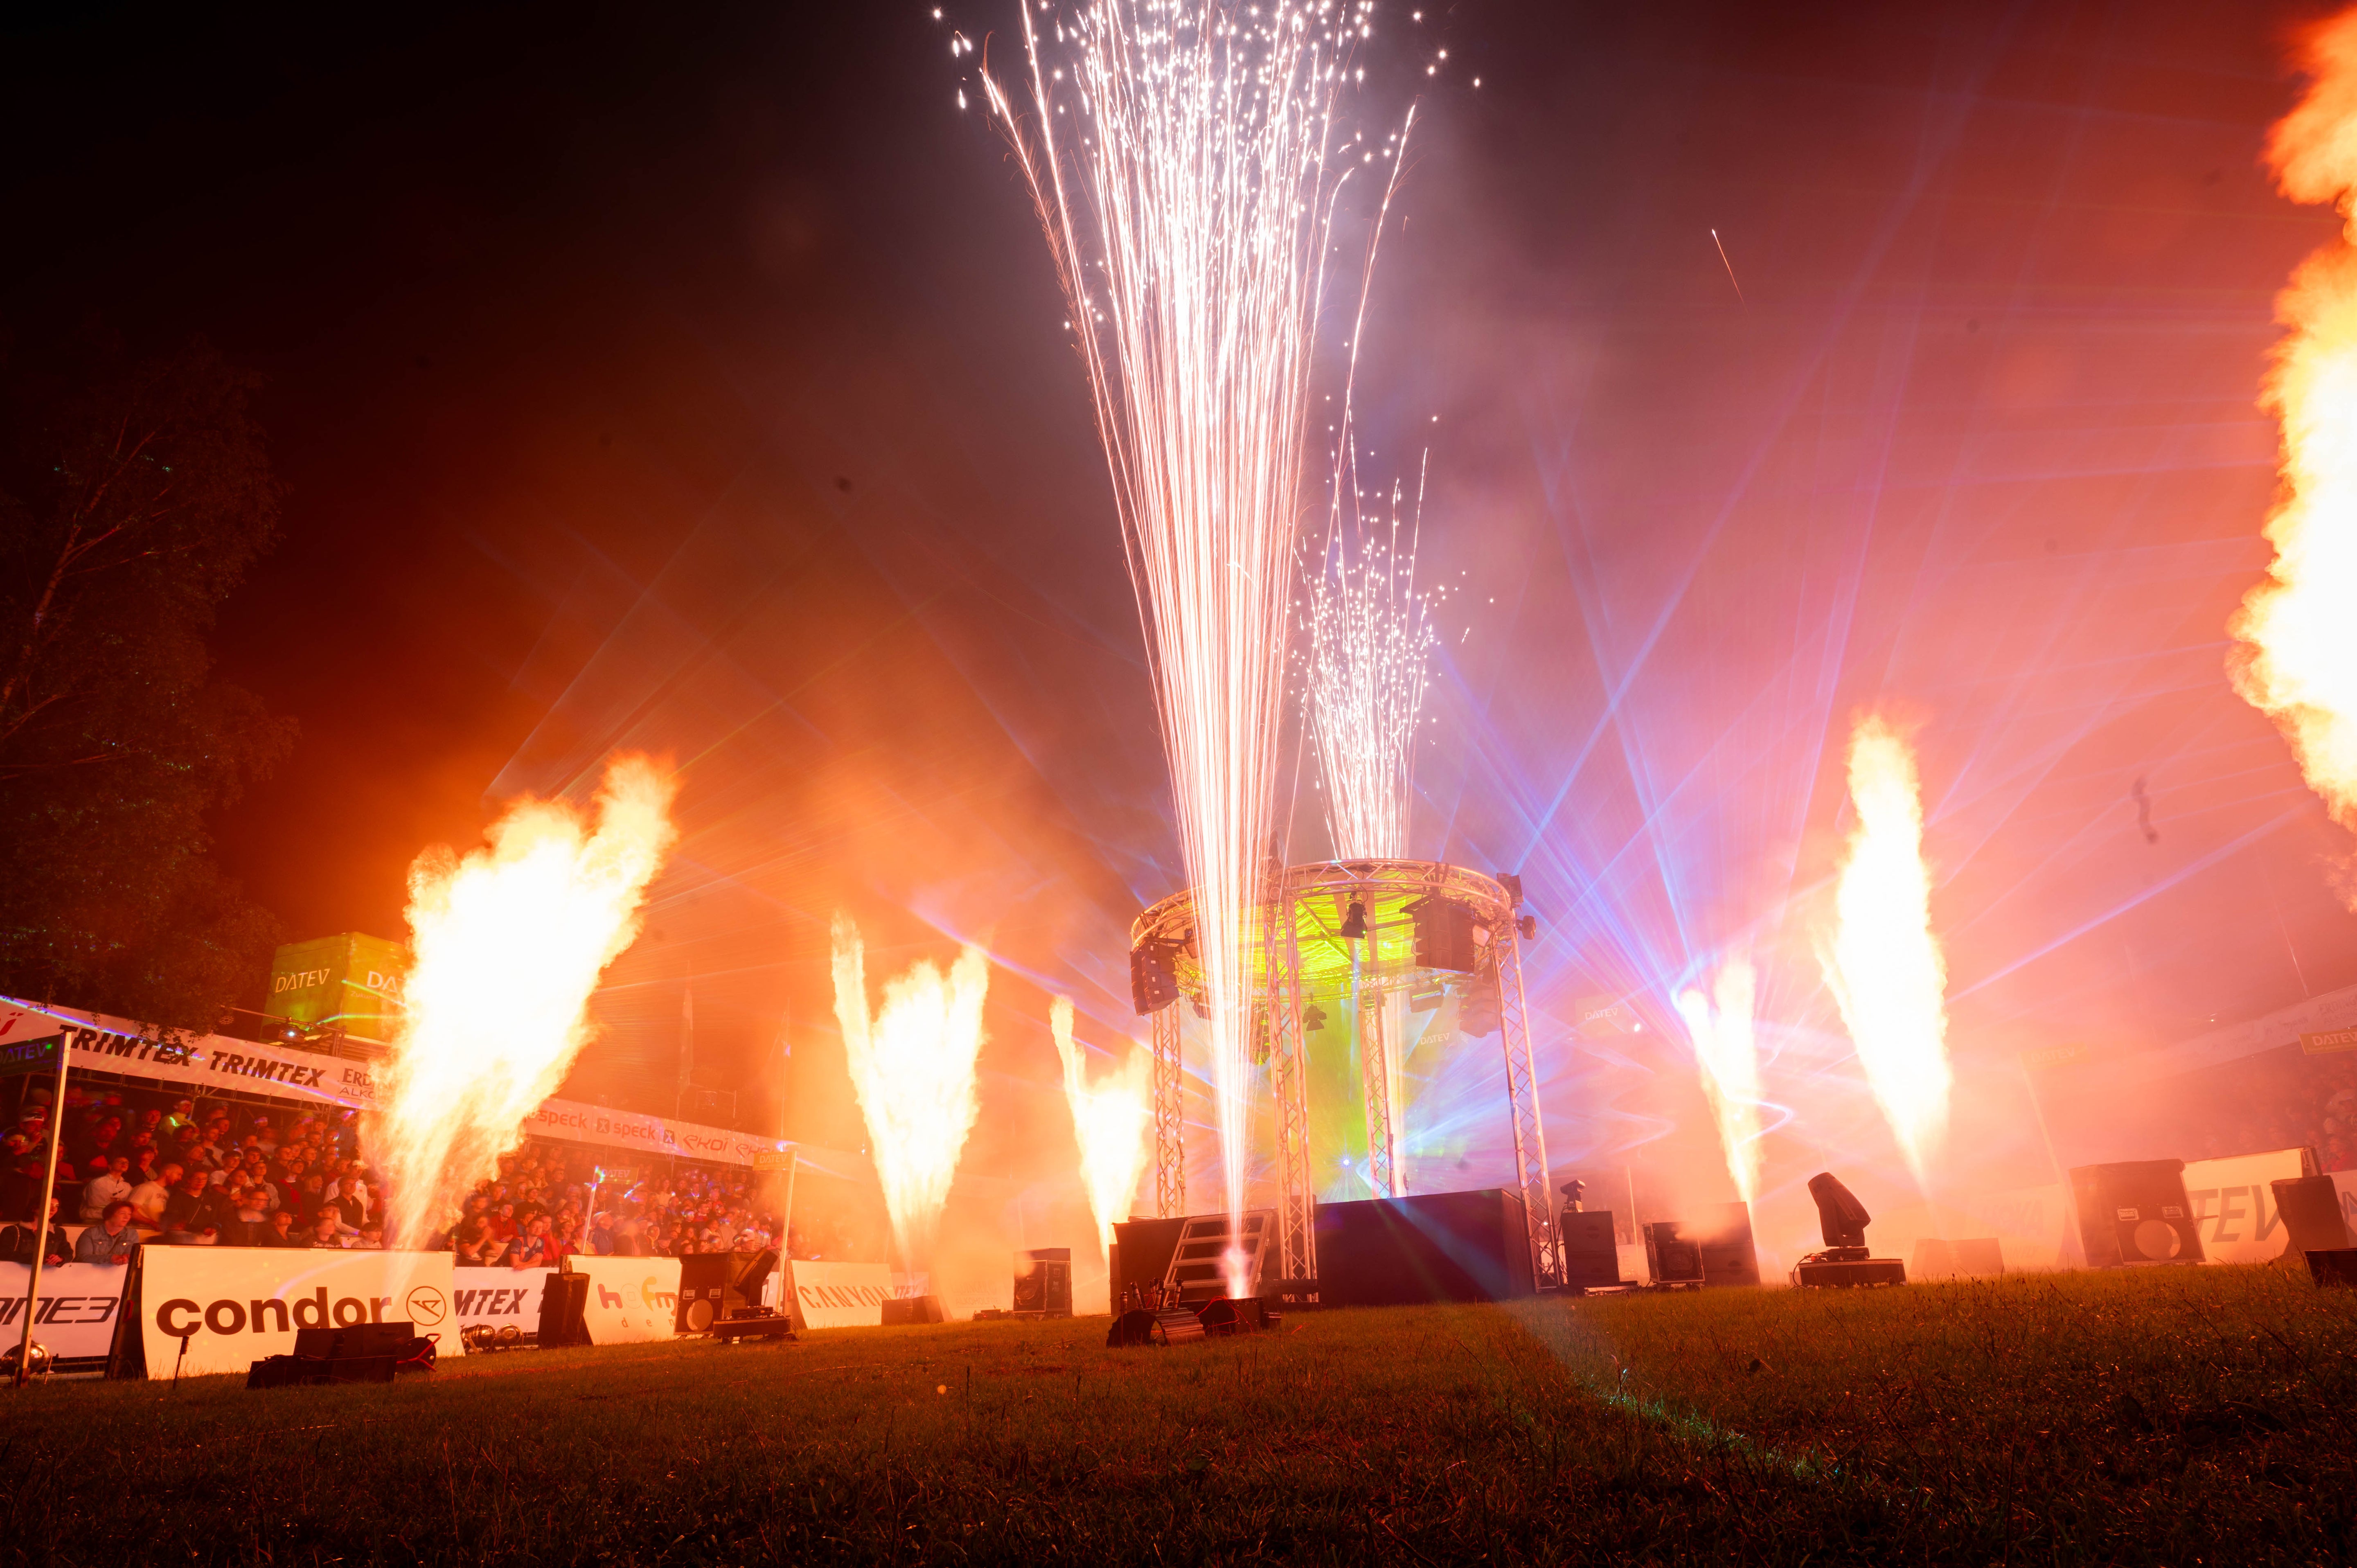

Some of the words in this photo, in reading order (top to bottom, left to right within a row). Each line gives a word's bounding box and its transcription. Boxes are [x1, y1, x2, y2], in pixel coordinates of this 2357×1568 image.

[275, 968, 330, 993] DATEV
[366, 970, 404, 994] DA
[1585, 1007, 1618, 1021] DATEV
[1420, 1032, 1450, 1045] DATEV
[2312, 1032, 2357, 1046] DATEV
[2030, 1047, 2075, 1063] DATEV
[210, 1050, 326, 1088] TRIMTEX
[539, 1110, 588, 1129] speck
[614, 1123, 656, 1140] speck
[759, 1154, 787, 1164] DATEV
[798, 1286, 892, 1308] CANYON
[156, 1287, 392, 1337] condor
